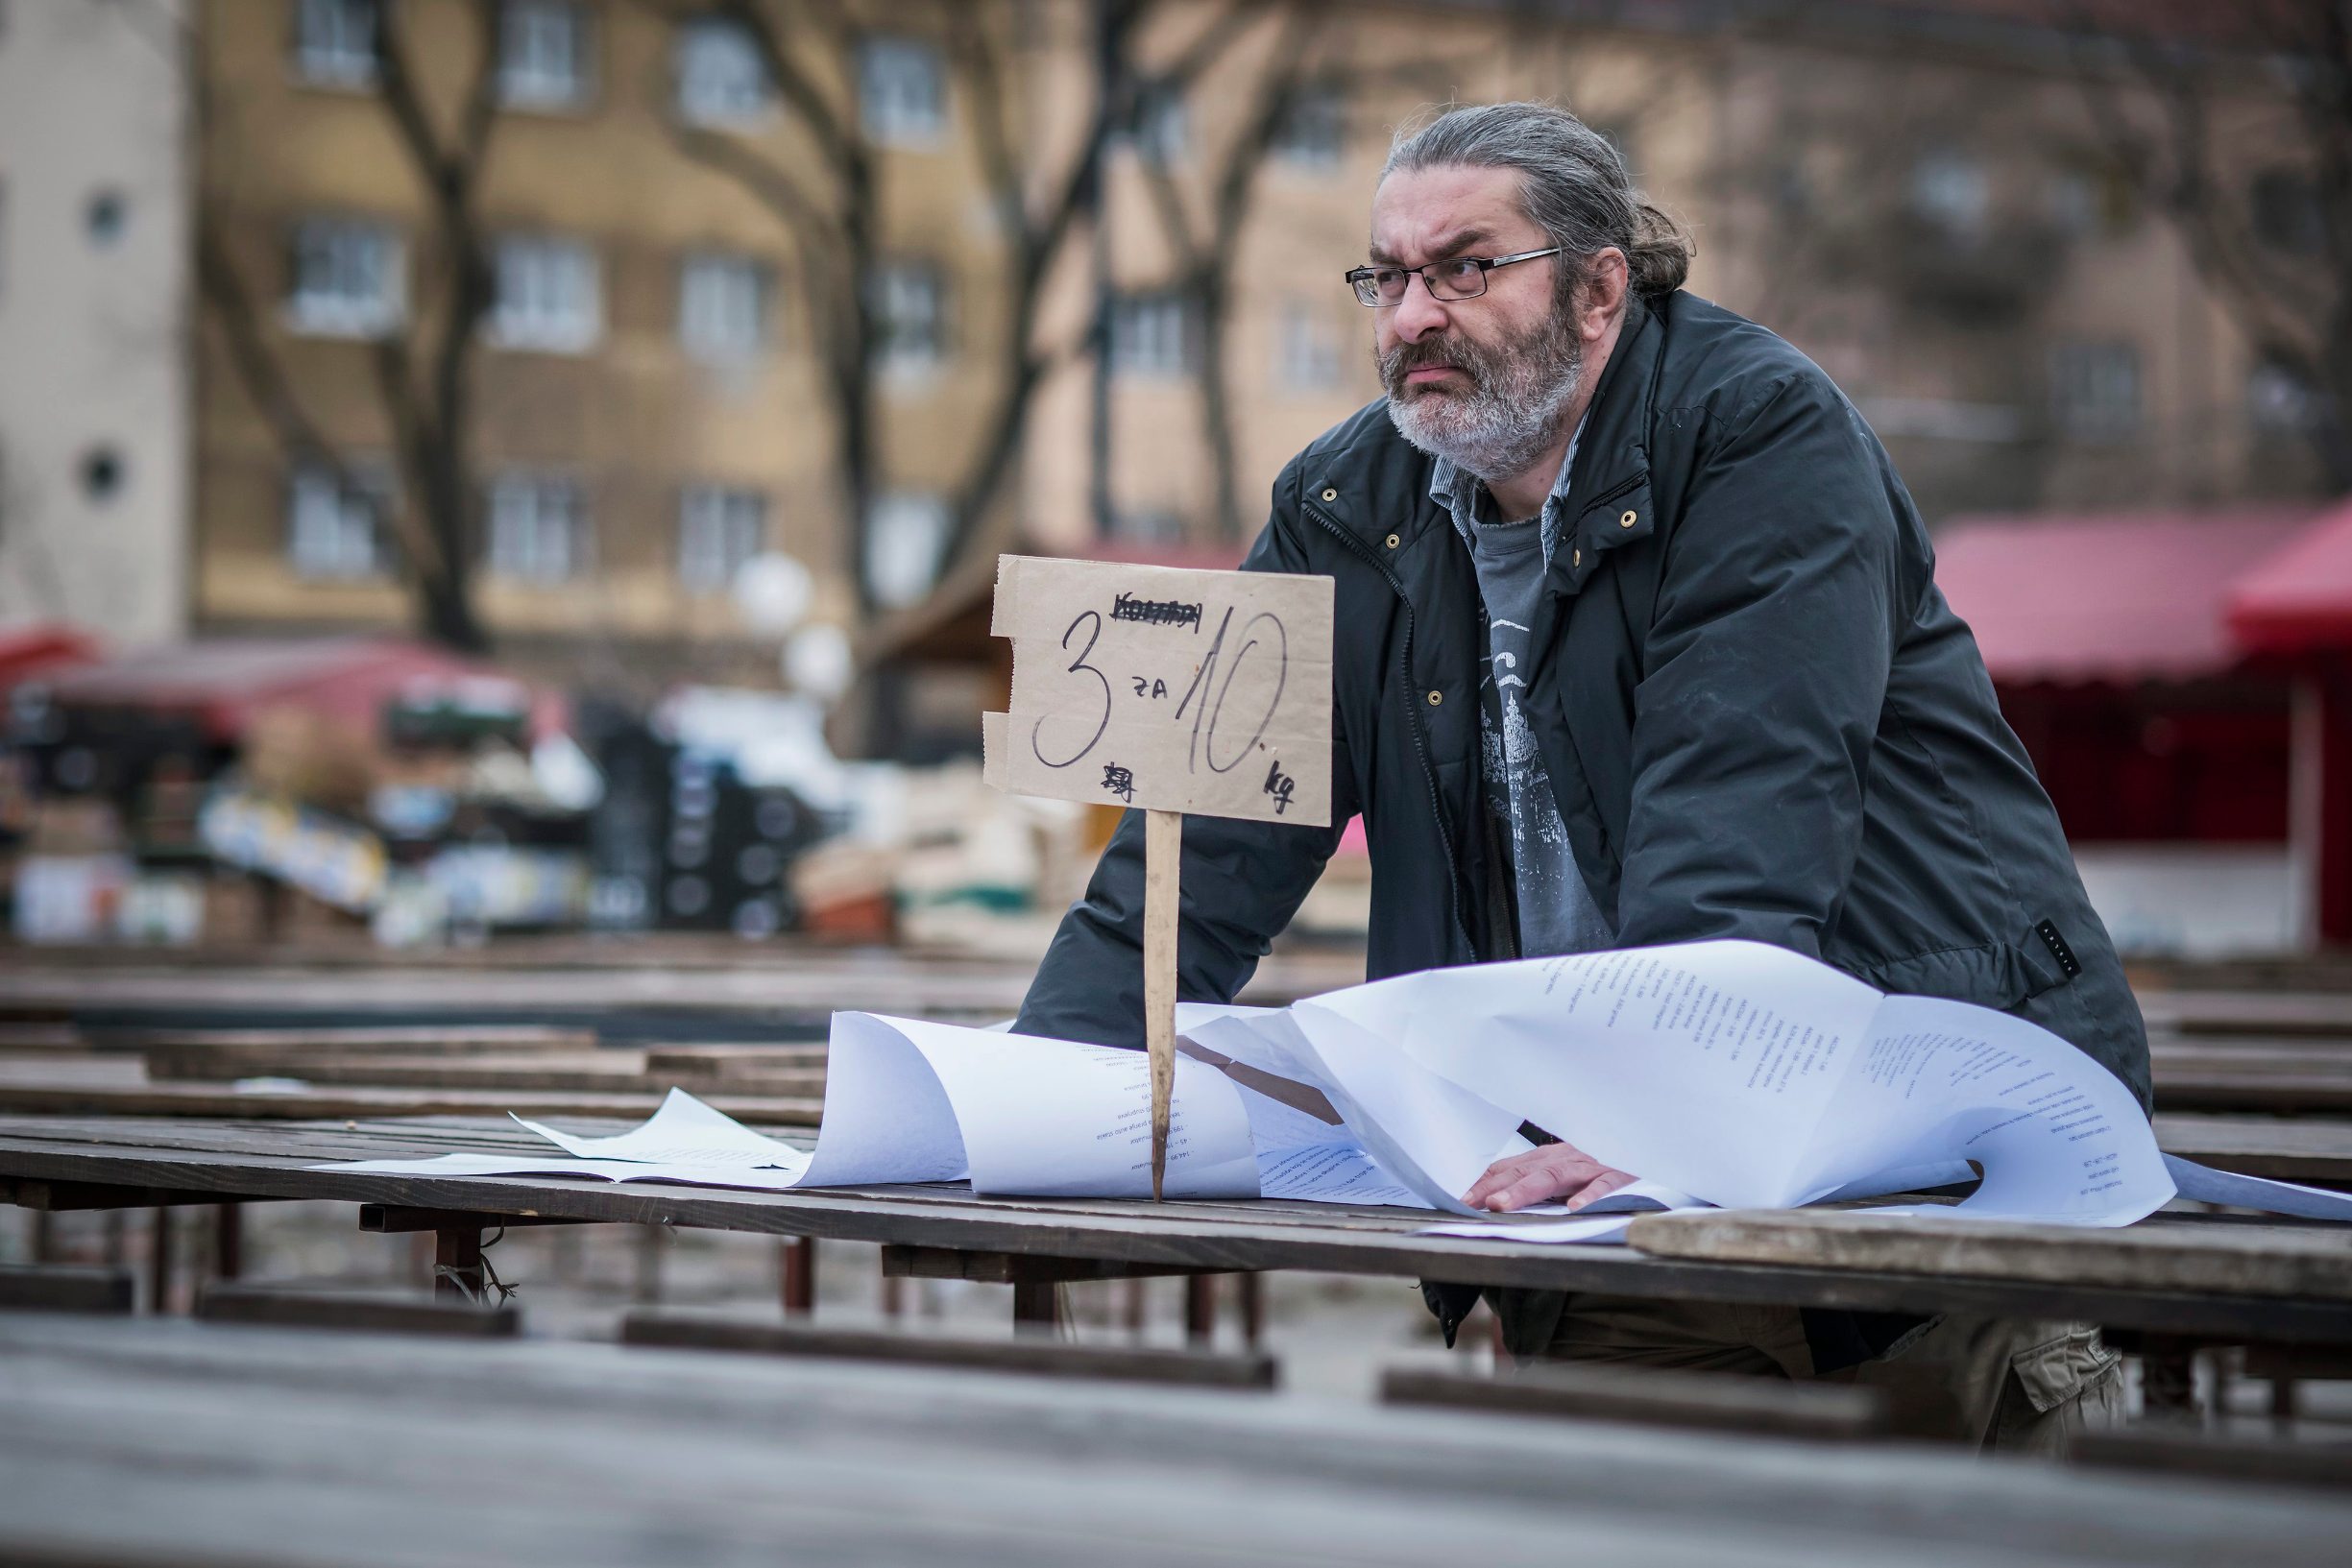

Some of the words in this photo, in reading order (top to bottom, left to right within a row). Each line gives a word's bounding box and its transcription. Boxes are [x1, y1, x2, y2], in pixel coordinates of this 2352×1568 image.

[1032, 610, 1111, 768] 3
[1176, 606, 1287, 774] 10
[1263, 760, 1295, 815] kg
